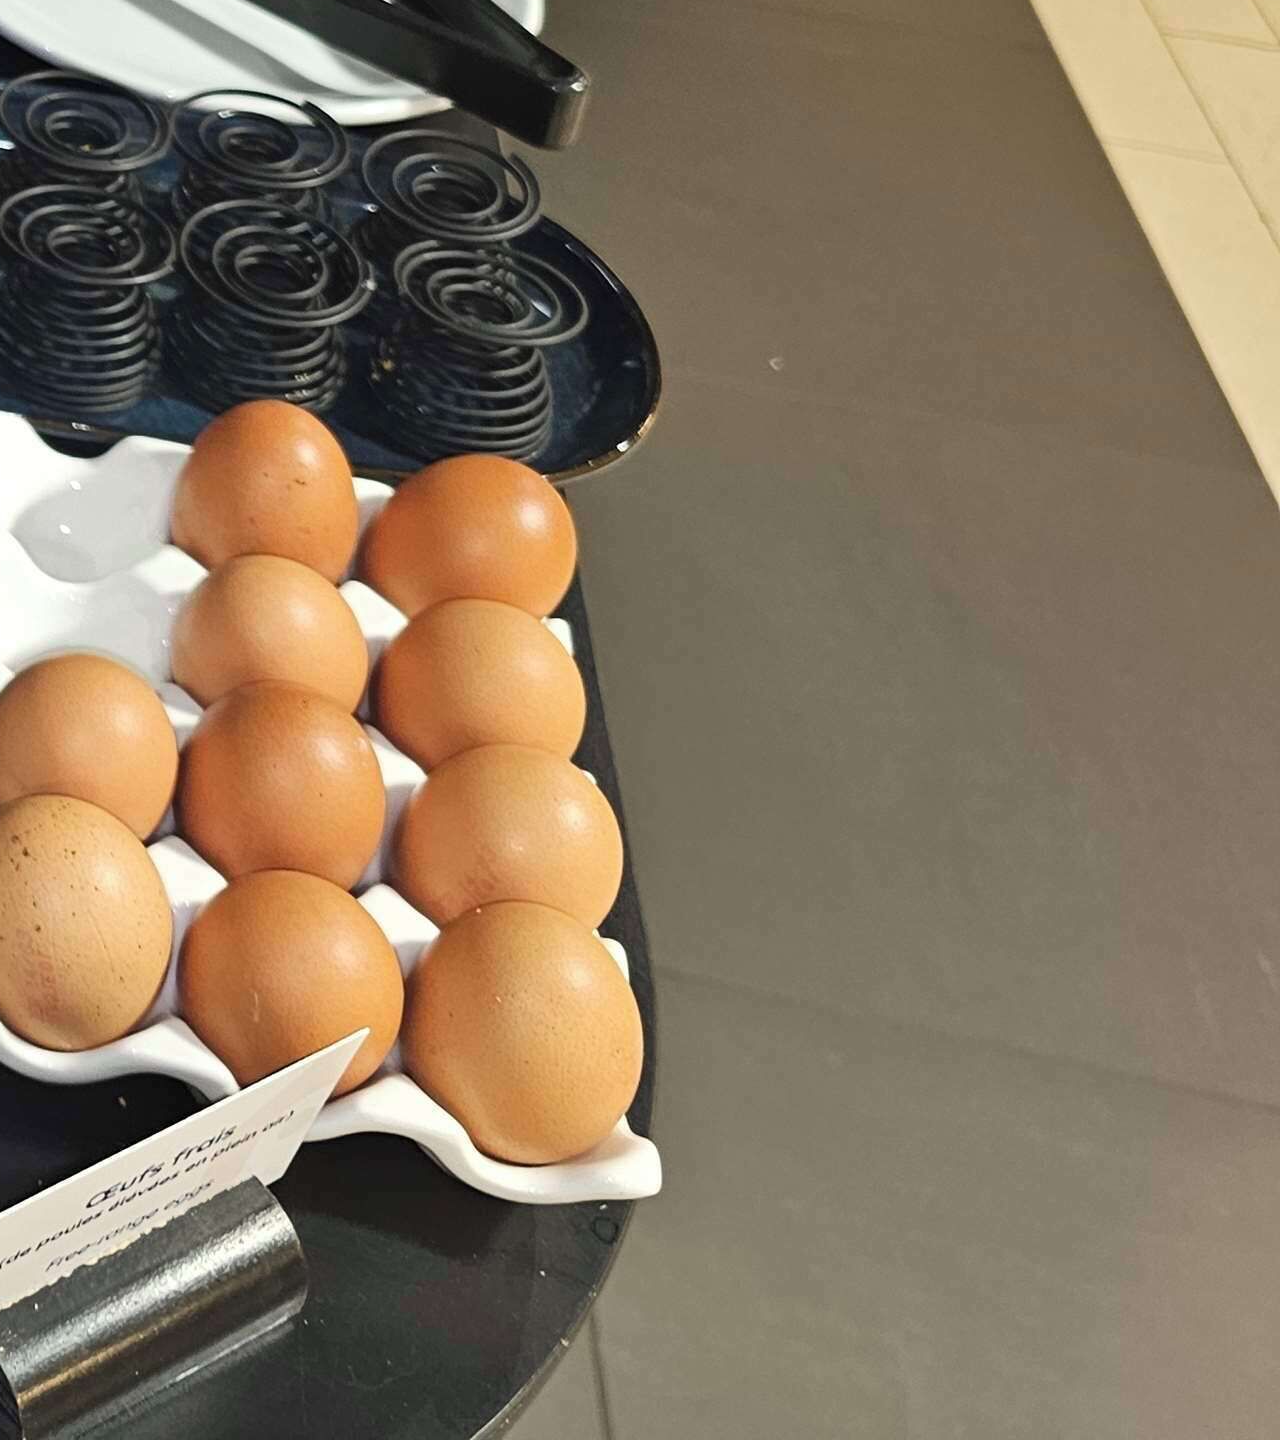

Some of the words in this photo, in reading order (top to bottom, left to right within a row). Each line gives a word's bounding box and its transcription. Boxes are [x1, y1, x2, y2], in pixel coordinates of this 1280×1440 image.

[34, 1210, 104, 1252] poules
[108, 1172, 180, 1213] élevées
[185, 1154, 209, 1173] en
[210, 1129, 258, 1163] plein
[85, 1161, 166, 1210] Œufs
[172, 1125, 238, 1166] frais
[44, 1207, 159, 1273] Free-range
[163, 1177, 216, 1212] eggs
